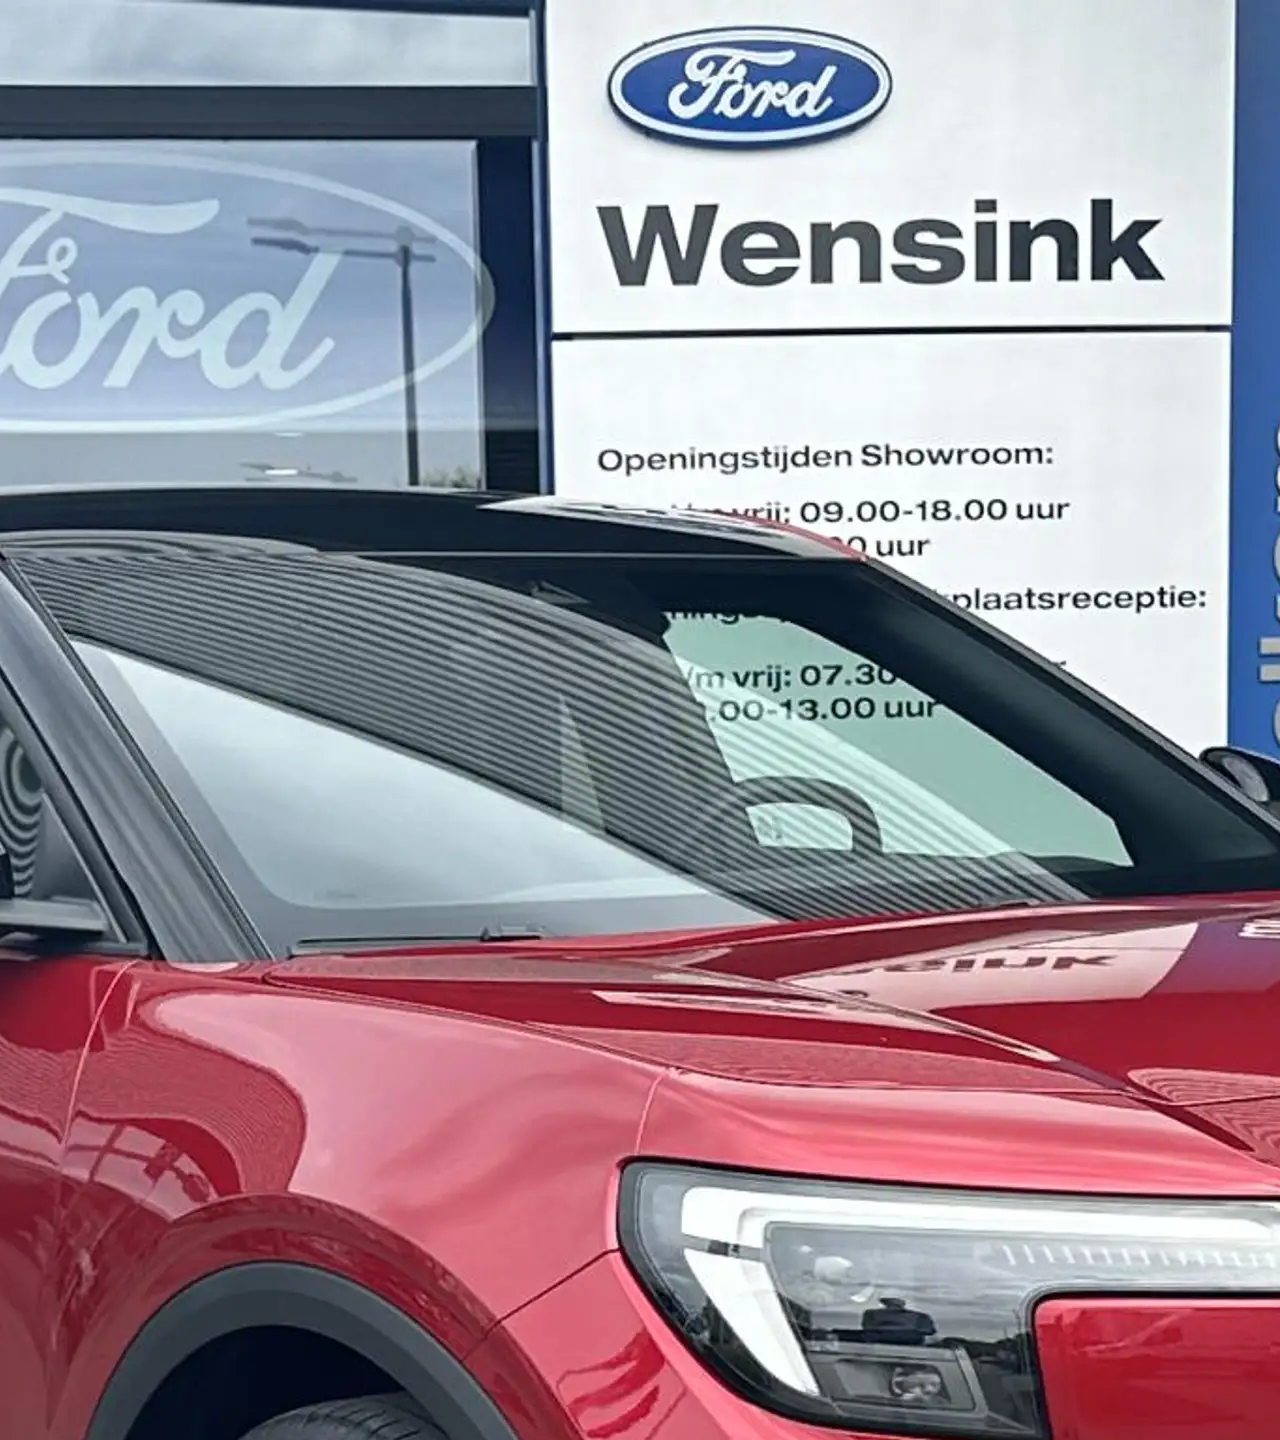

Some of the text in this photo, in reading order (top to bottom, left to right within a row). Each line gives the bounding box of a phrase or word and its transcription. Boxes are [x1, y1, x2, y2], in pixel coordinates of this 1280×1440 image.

[668, 47, 838, 120] Ford
[596, 199, 1166, 287] Wensink
[597, 443, 1054, 477] Openingstijden Showroom:
[799, 499, 1008, 524] 09.00-18.00
[1015, 500, 1070, 520] uur
[876, 538, 930, 557] uur
[942, 585, 1207, 614] plaatsreceptie:
[685, 663, 897, 692] /m vrij: 07.30
[709, 696, 937, 721] .00-13.00 uur
